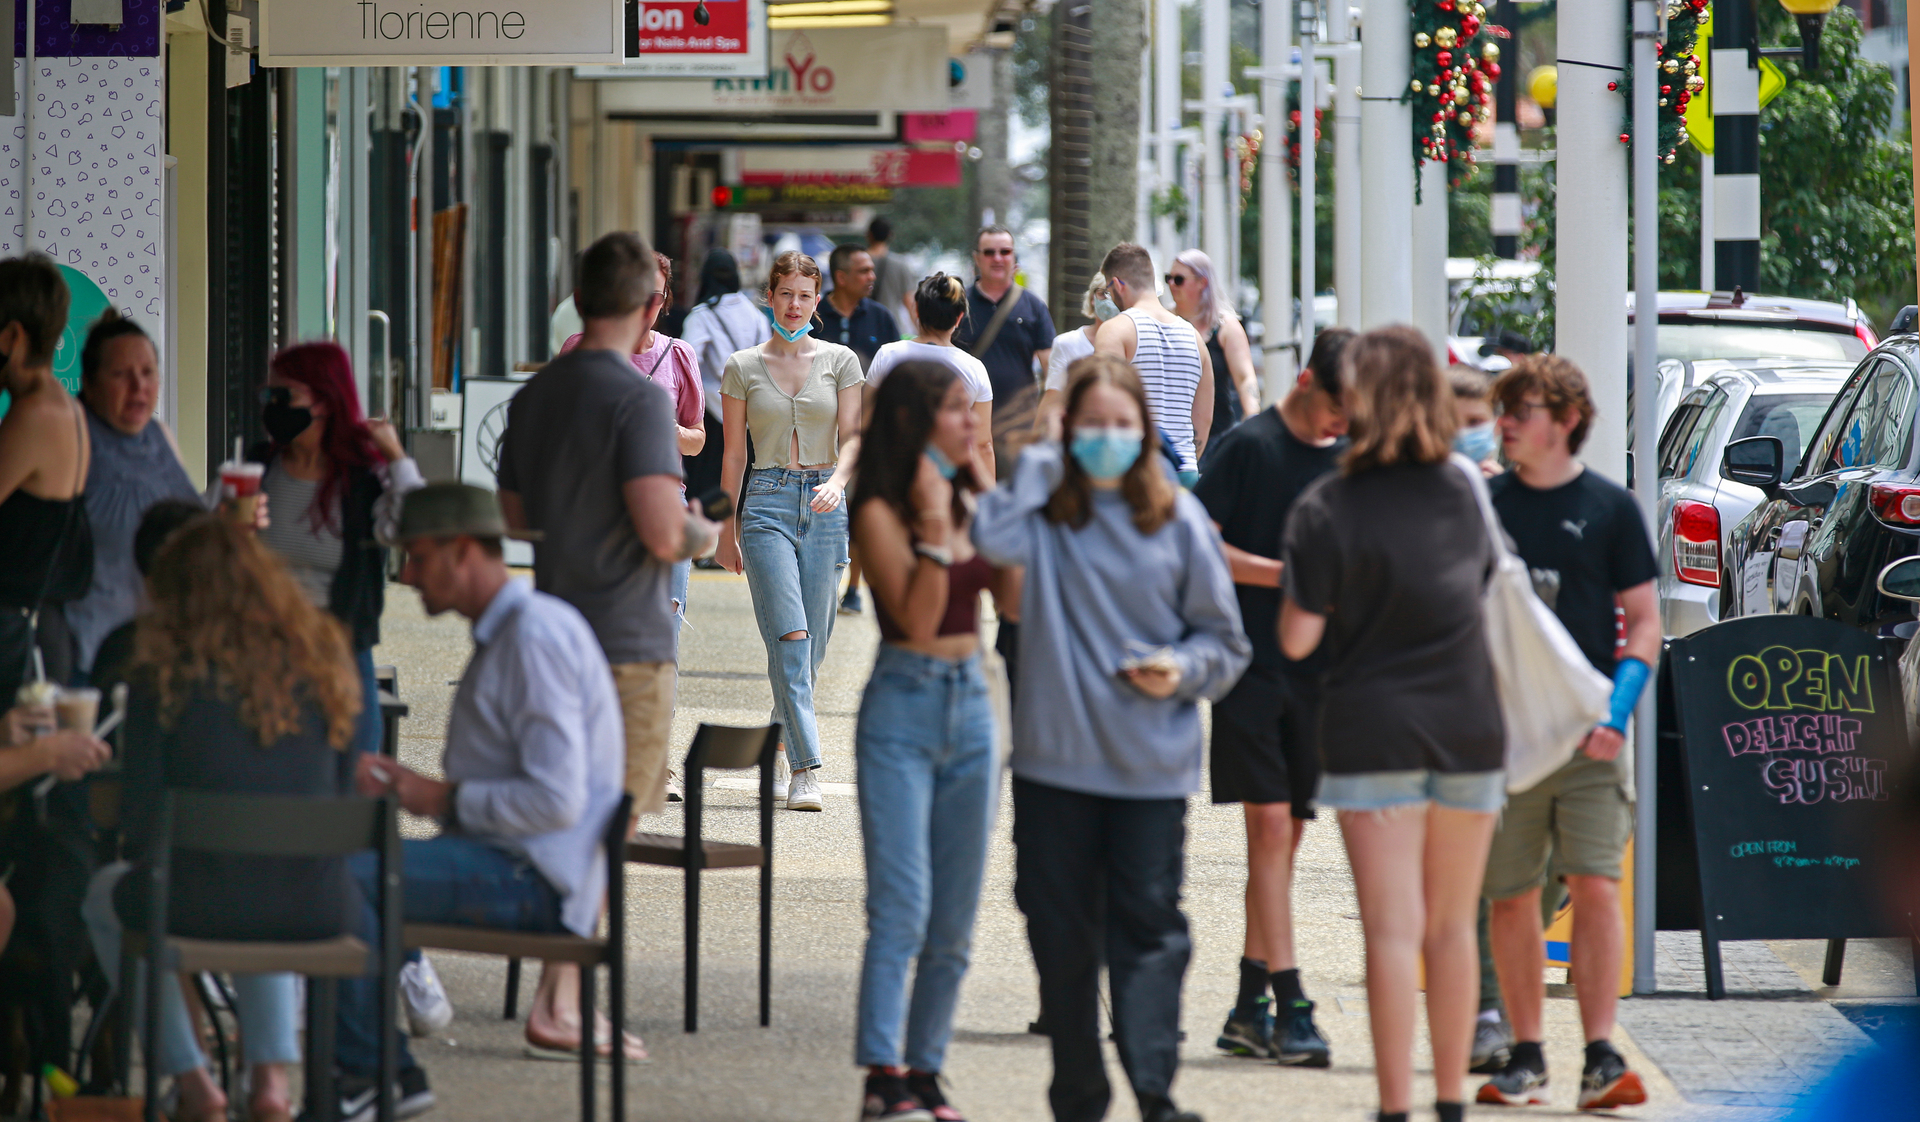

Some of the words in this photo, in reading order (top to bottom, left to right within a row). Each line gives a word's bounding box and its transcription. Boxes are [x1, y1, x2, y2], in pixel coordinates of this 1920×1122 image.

[639, 37, 653, 49] or
[654, 36, 686, 49] Nails
[687, 36, 714, 49] And
[714, 36, 740, 51] Spa
[1727, 645, 1875, 713] OPEN
[1763, 756, 1889, 805] SUSHI
[1730, 841, 1764, 858] OPEN
[1766, 840, 1797, 853] FROM
